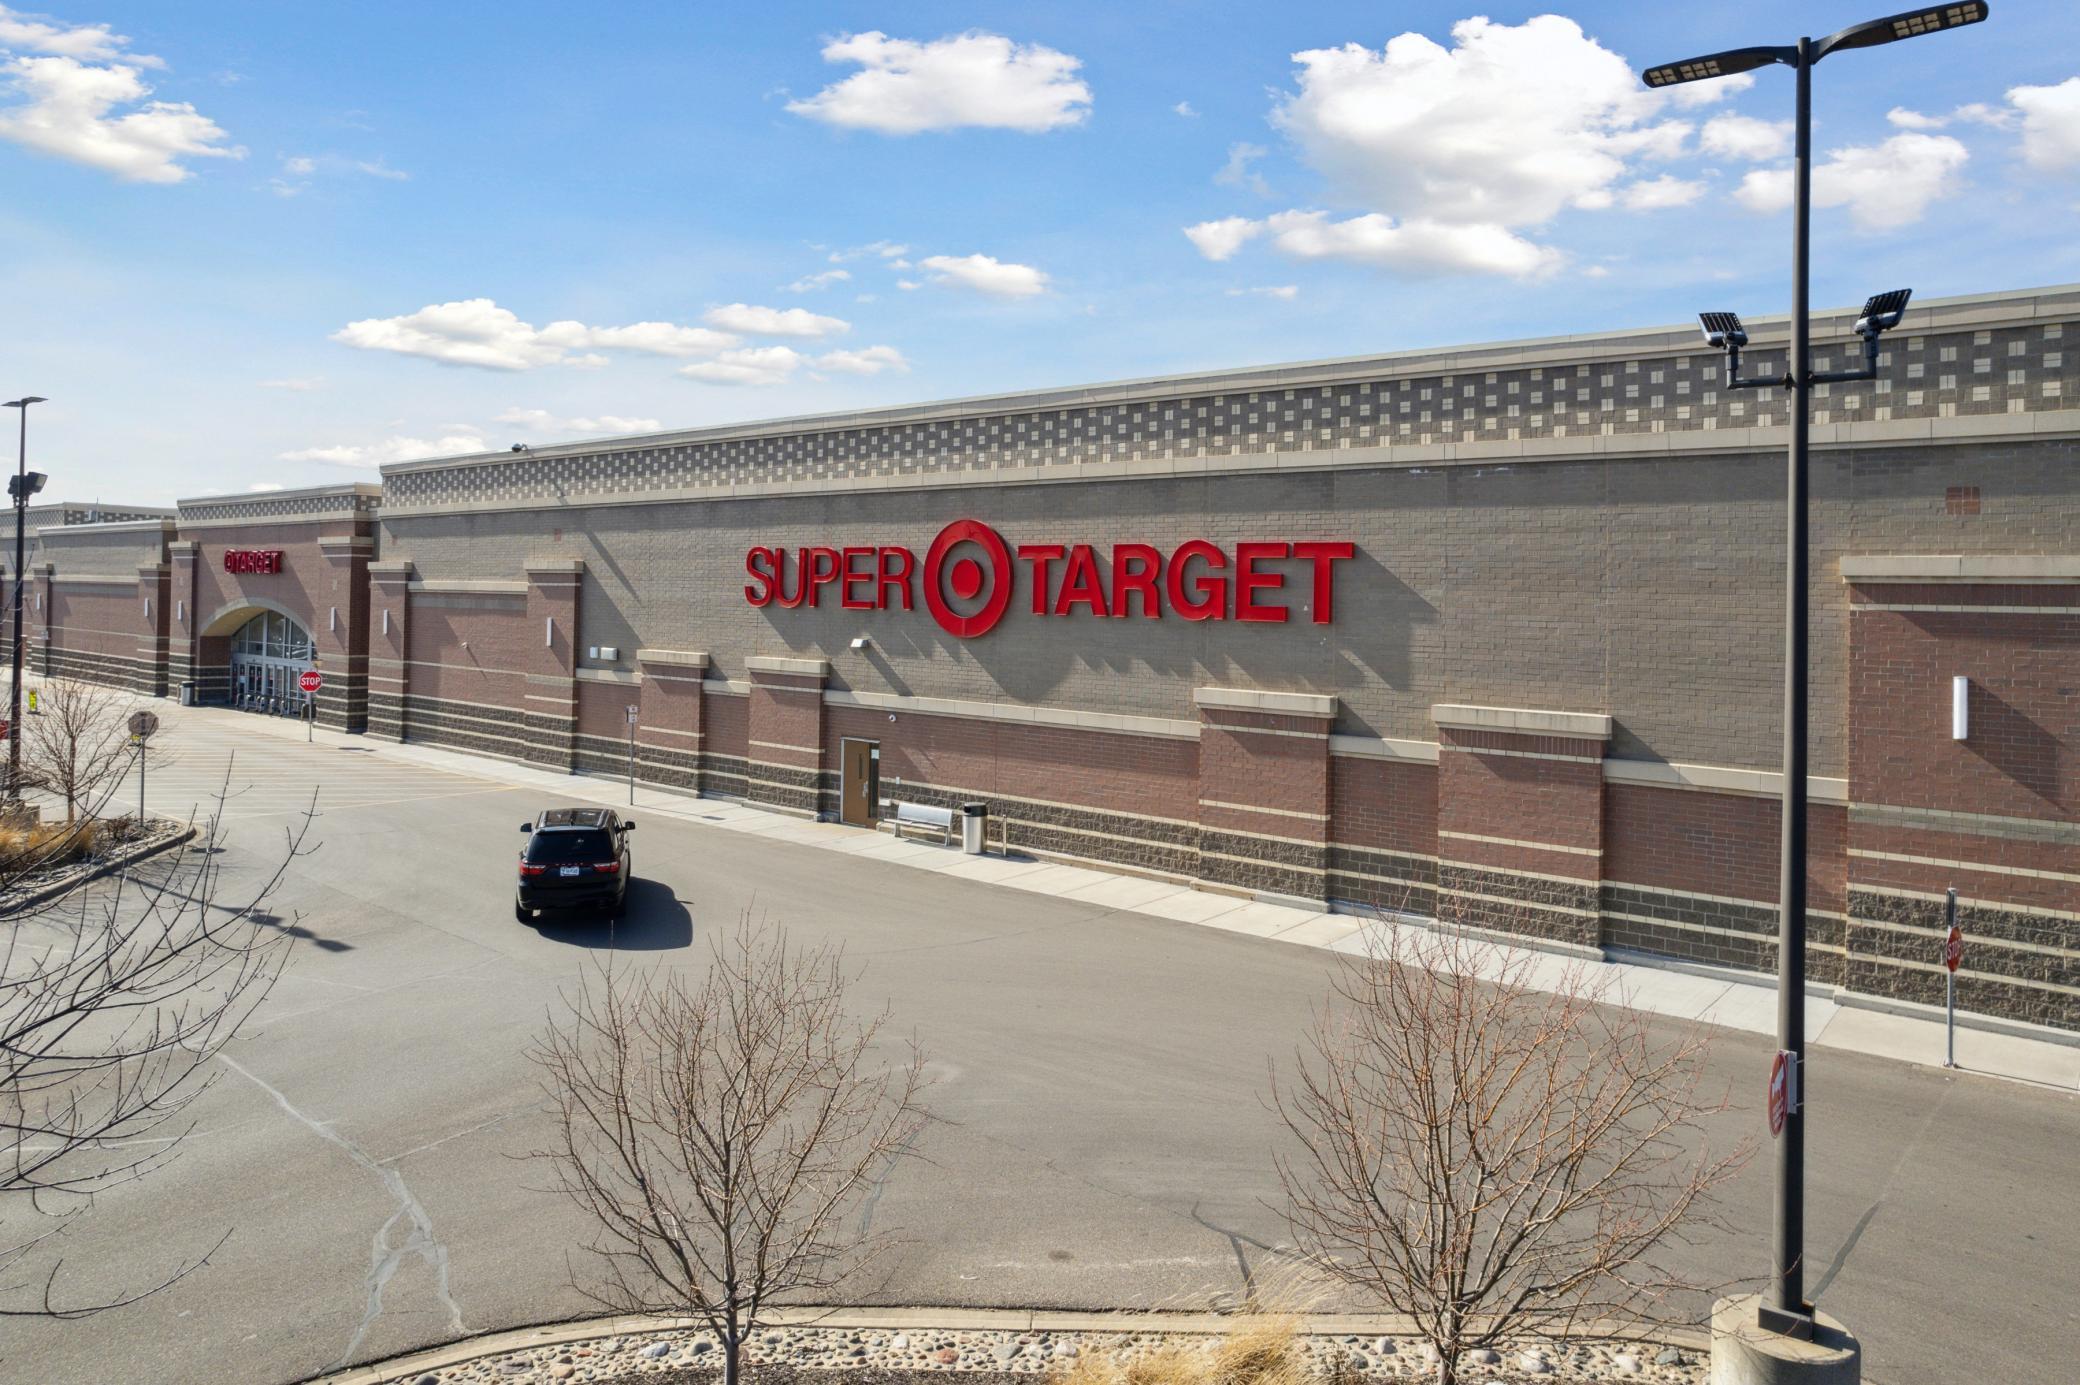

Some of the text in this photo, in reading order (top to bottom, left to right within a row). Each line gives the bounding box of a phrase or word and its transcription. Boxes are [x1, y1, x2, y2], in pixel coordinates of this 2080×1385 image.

[235, 551, 282, 573] TARGET
[745, 539, 1356, 624] SUPER TARGET
[300, 677, 321, 686] STOP
